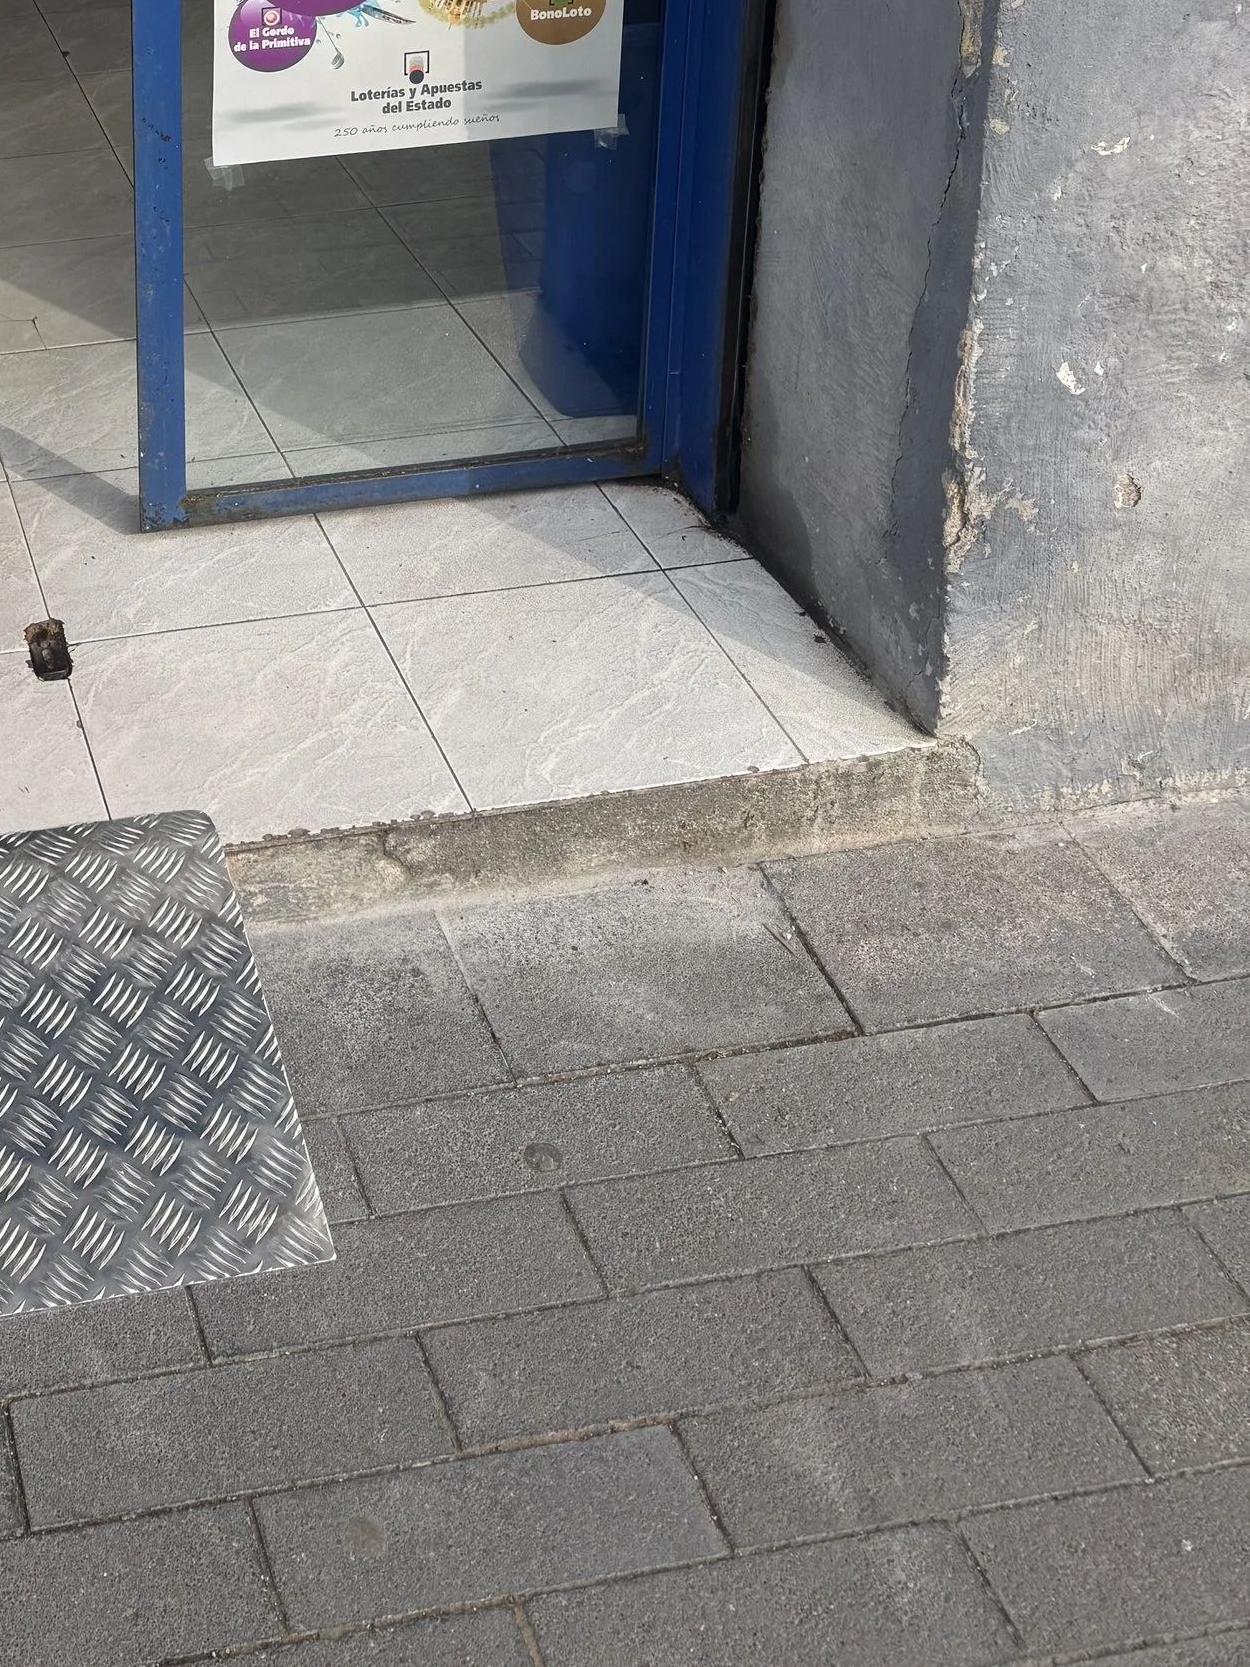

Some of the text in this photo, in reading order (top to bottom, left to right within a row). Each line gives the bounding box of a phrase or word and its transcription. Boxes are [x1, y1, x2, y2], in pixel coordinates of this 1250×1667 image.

[530, 6, 592, 21] BonoLoto
[250, 26, 294, 38] El Gordo
[234, 36, 311, 52] de la Primitiva
[351, 79, 482, 102] Loterías y Apuestas
[382, 97, 452, 114] del Estado
[334, 113, 500, 138] 250 años cumpliendo sueños
